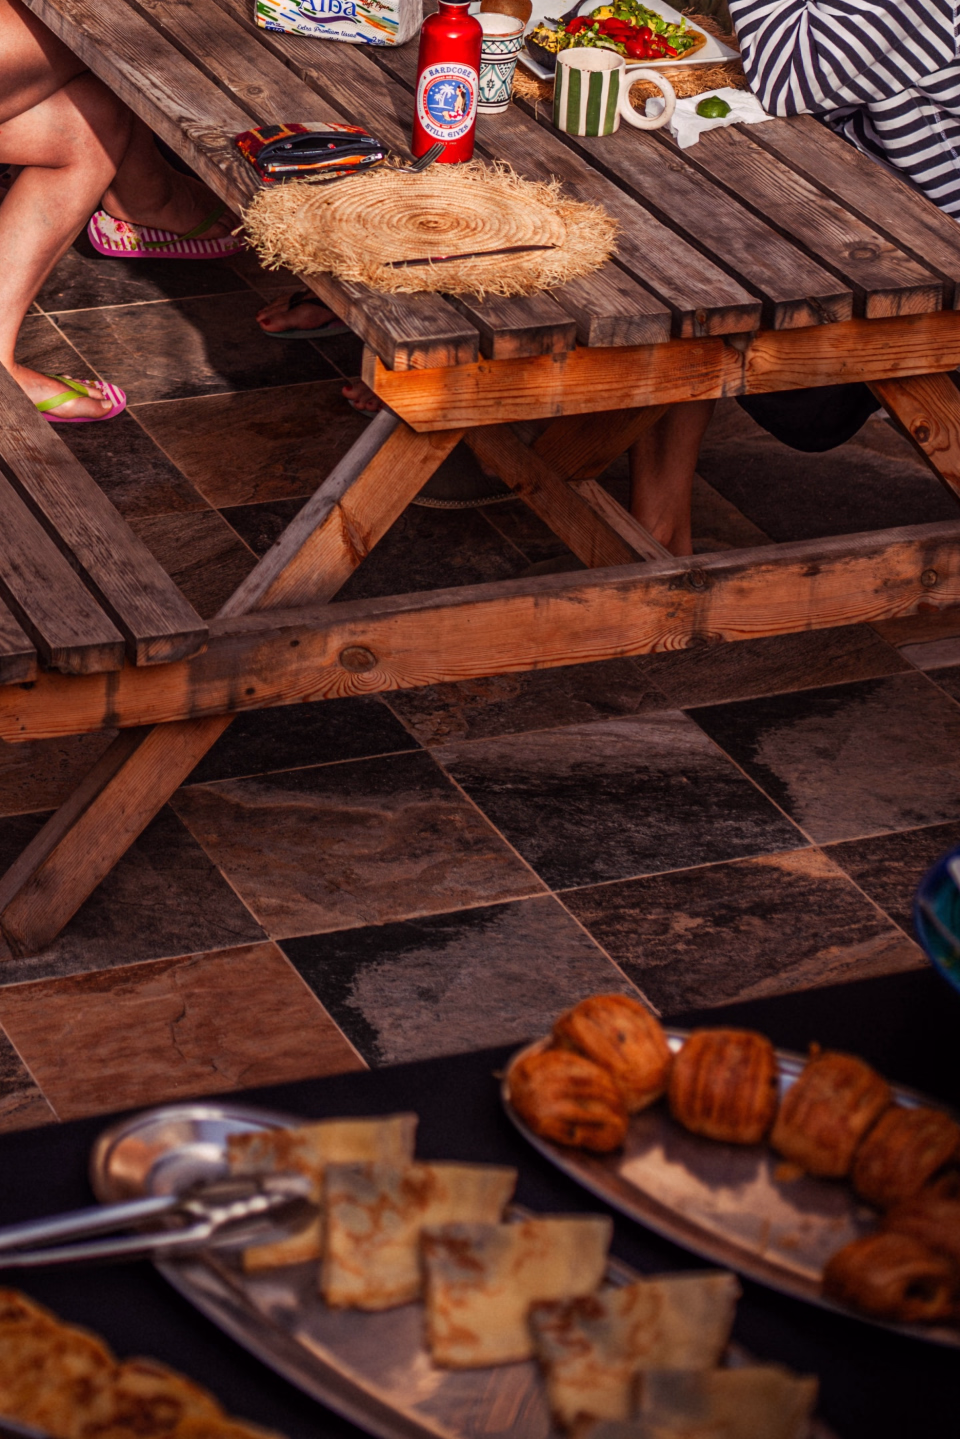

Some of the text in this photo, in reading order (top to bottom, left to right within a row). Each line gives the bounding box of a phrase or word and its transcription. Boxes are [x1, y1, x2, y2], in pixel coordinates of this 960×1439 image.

[296, 23, 312, 32] Extra
[428, 66, 472, 78] HARDCORE
[425, 123, 469, 138] STILL GIVES
